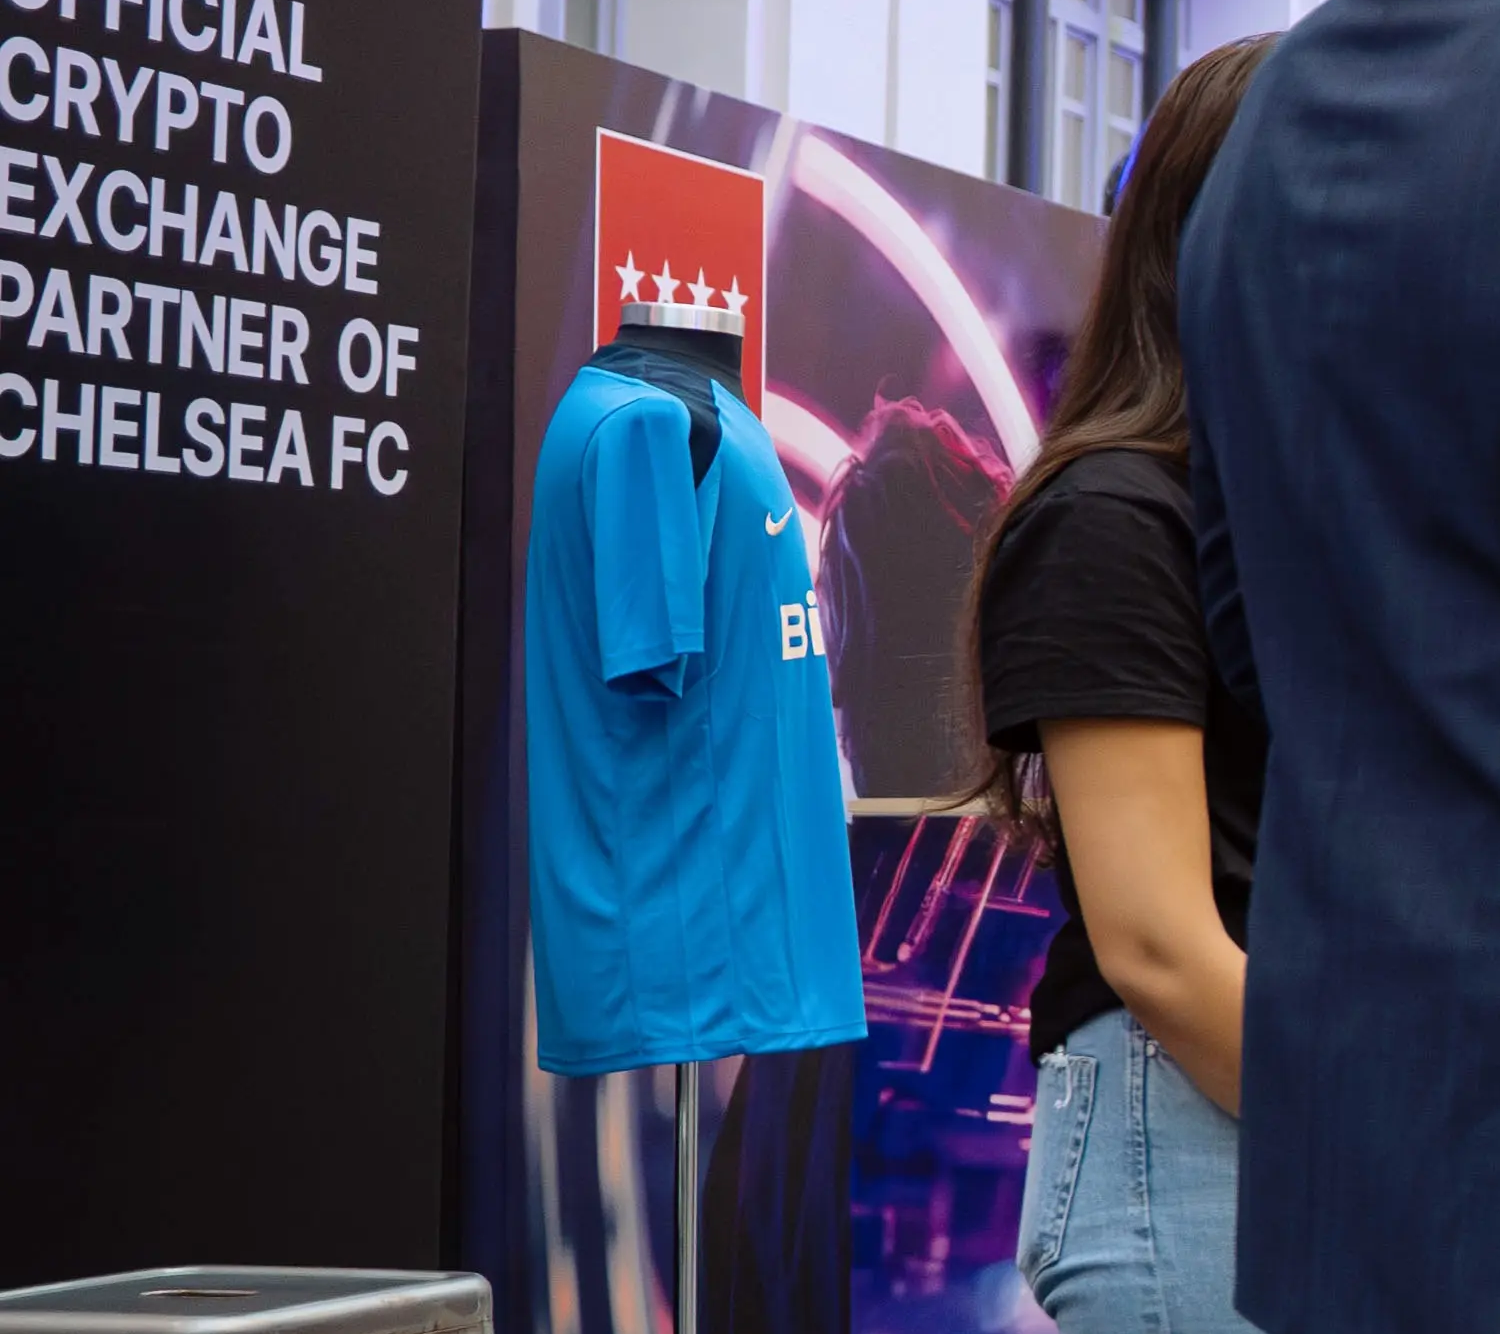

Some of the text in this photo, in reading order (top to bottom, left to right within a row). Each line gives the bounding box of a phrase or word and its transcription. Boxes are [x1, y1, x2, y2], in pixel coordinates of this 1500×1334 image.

[0, 35, 293, 174] CRYPTO
[0, 149, 381, 295] EXCHANGE
[0, 259, 420, 396] PARTNER OF
[0, 374, 410, 497] CHELSEA FC
[780, 590, 826, 661] Bi
